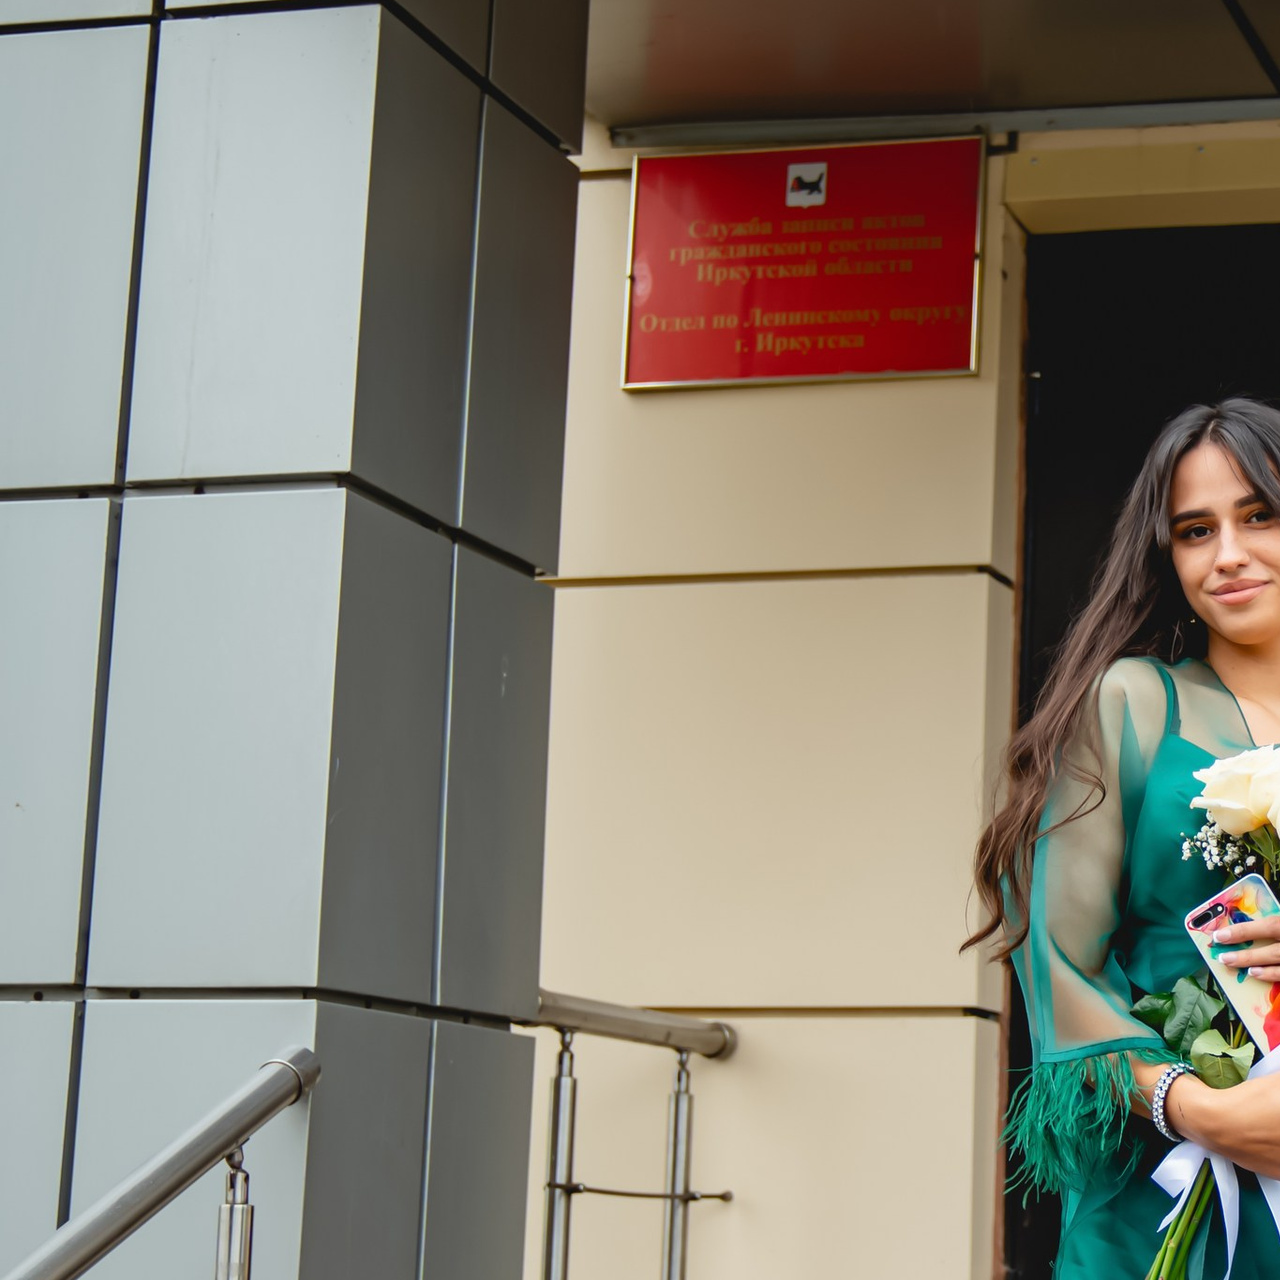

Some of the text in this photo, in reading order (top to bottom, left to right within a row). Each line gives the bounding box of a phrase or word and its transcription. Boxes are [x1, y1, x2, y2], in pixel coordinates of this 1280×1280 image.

[697, 256, 913, 286] Иркутской области
[639, 306, 965, 333] Отдел по Ленинскому округу
[735, 333, 864, 356] г. Иркутска
